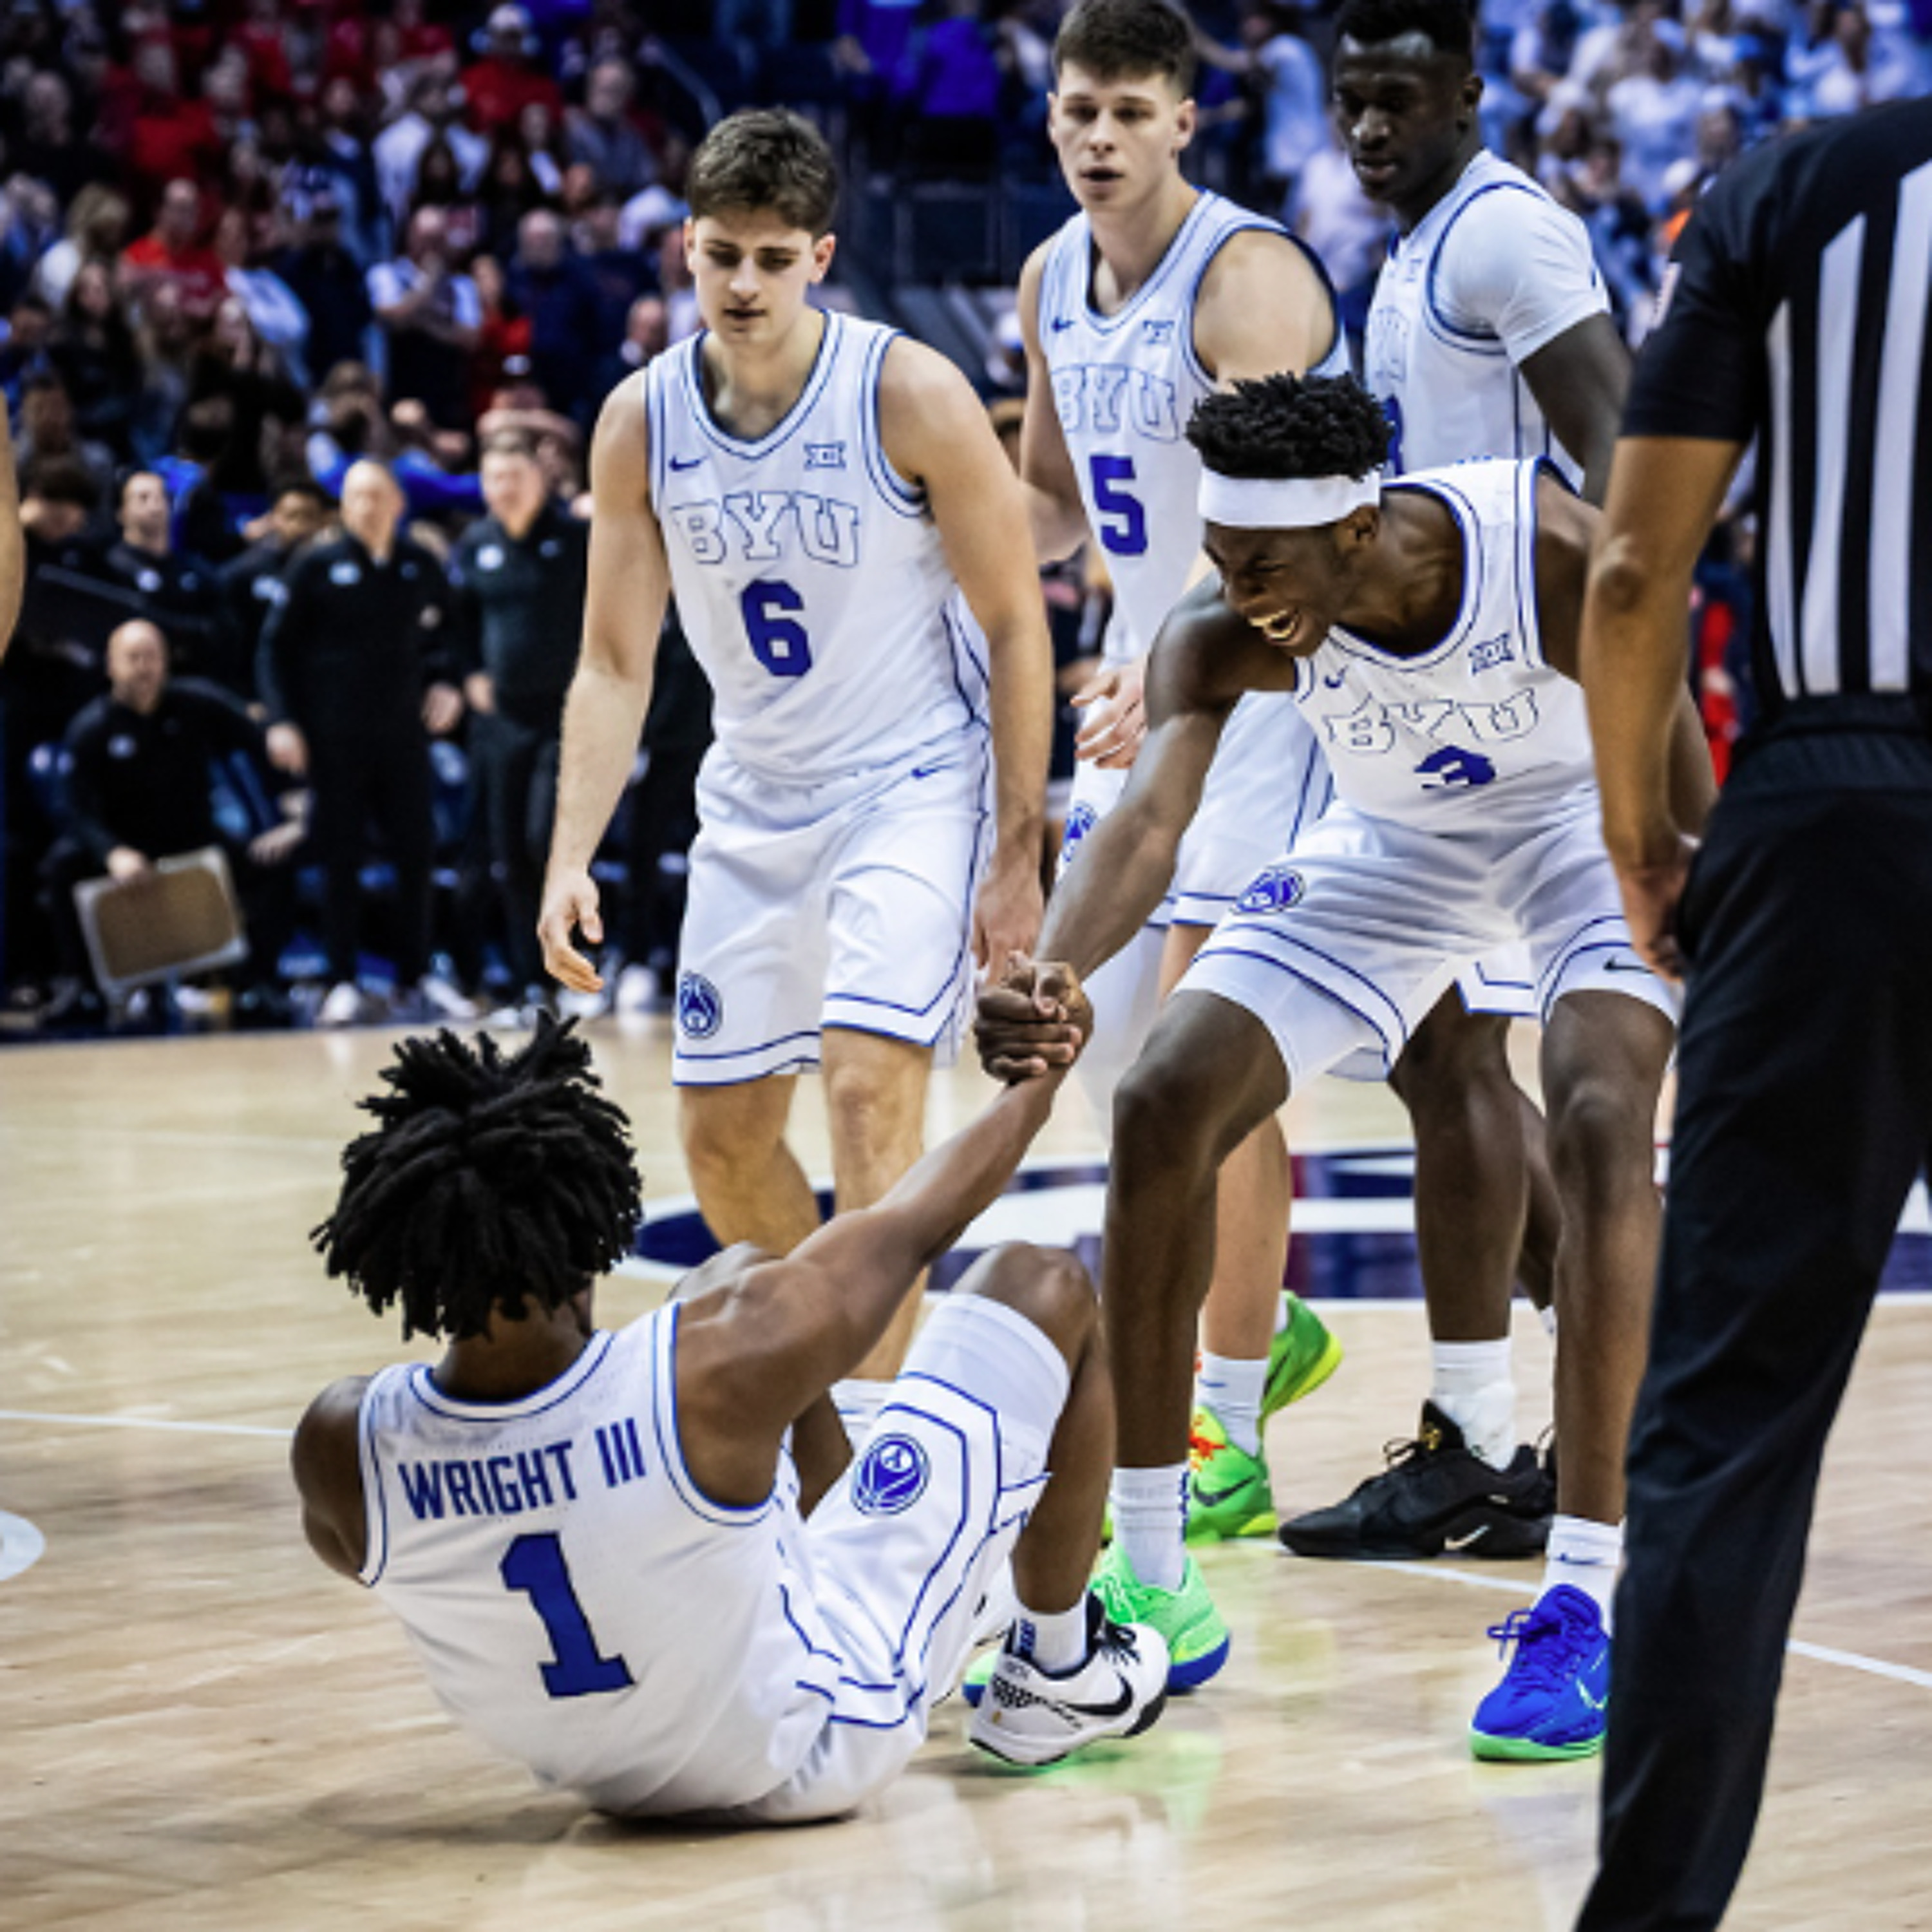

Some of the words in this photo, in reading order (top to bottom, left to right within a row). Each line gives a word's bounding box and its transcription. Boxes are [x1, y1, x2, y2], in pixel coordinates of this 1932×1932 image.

[1051, 363, 1180, 442] BYU
[669, 491, 859, 567] BYU
[1090, 455, 1148, 556] 5
[741, 578, 812, 677] 6
[1322, 688, 1539, 754] BYU
[1414, 744, 1497, 790] 3
[397, 1440, 576, 1520] WRIGHT
[594, 1417, 646, 1488] III
[498, 1530, 636, 1698] 1
